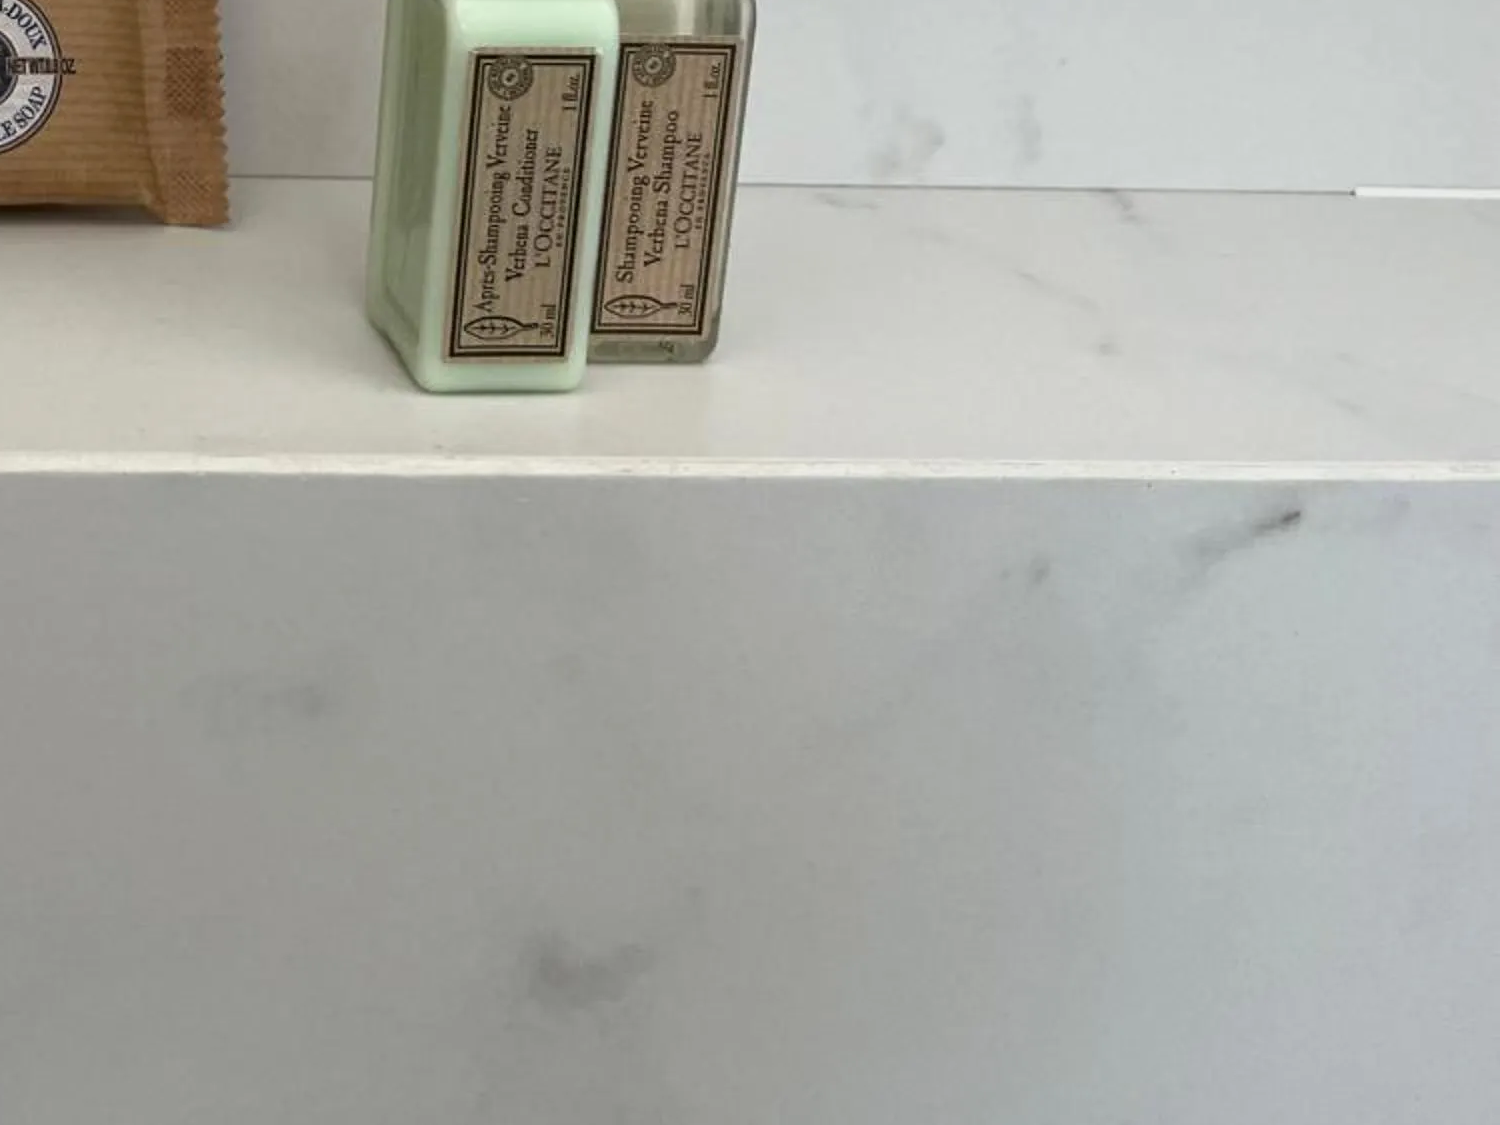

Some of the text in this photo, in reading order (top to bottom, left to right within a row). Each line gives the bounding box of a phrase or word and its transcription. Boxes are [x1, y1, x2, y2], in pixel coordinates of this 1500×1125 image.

[14, 86, 48, 131] SOAP
[485, 104, 511, 169] Verveine
[627, 100, 654, 172] Verveine
[652, 110, 682, 194] Shampoo
[674, 132, 702, 249] L'OCCITANE
[505, 129, 540, 282] Verbena Conditioner
[533, 146, 563, 268] L'OCCITANE
[615, 175, 650, 284] Shampooing
[644, 200, 669, 267] Verbena
